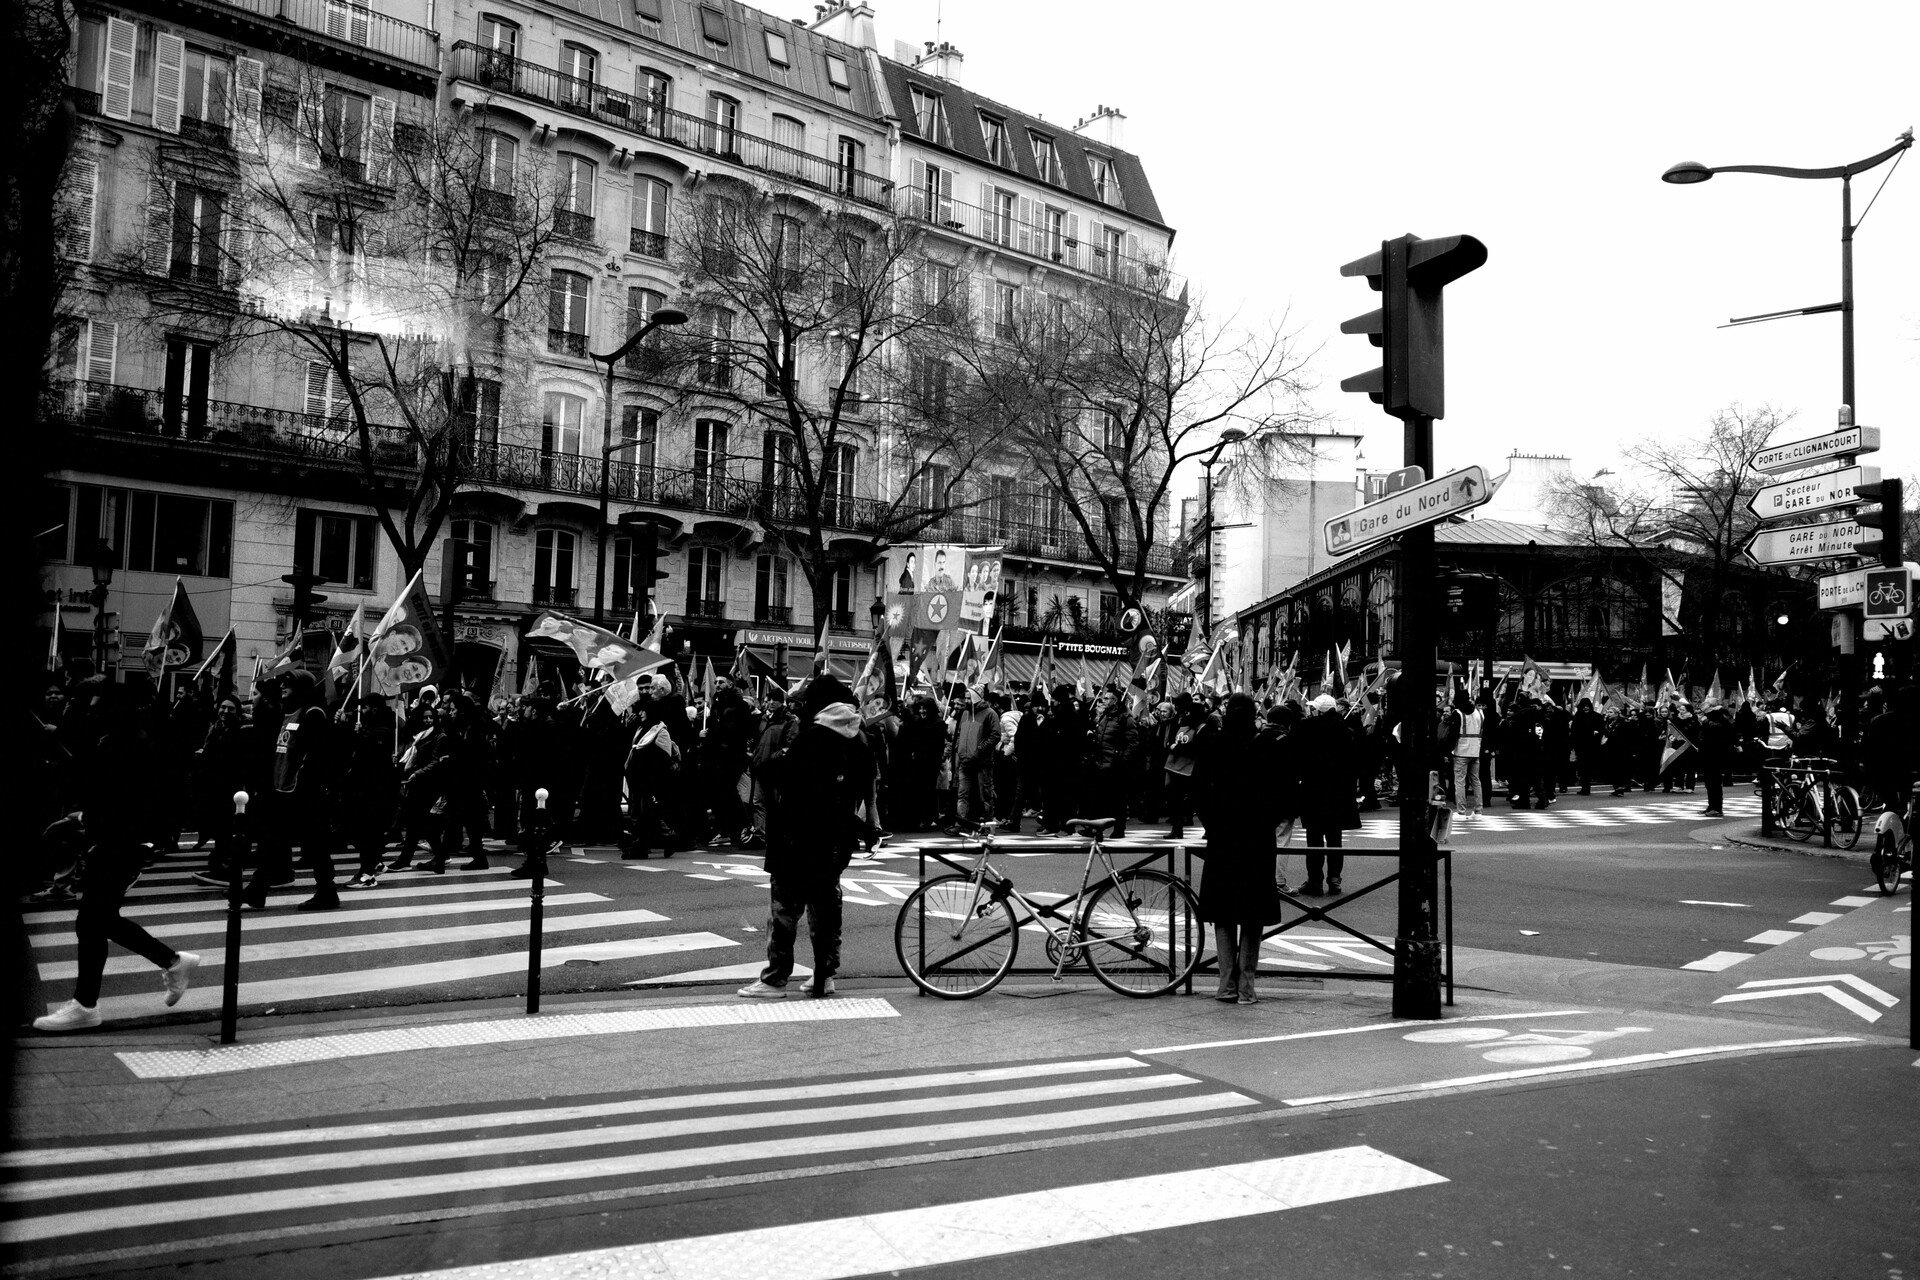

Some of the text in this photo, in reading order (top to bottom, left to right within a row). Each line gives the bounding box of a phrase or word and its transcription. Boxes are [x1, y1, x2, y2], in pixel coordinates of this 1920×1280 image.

[1758, 452, 1782, 465] PORTE
[1794, 434, 1857, 457] CLIGNANCOURT
[1398, 472, 1406, 487] 7
[1786, 483, 1820, 496] Secteur
[1786, 496, 1811, 509] GARE
[1829, 488, 1854, 500] NOR
[1360, 488, 1450, 532] Gare du Nord
[1790, 531, 1814, 543] GARE
[1833, 525, 1861, 537] NORD
[1789, 541, 1852, 555] Arrêt Minute
[1821, 586, 1841, 597] PORTE
[762, 634, 793, 644] ARTISAN
[1084, 644, 1127, 655] BOUGNATE
